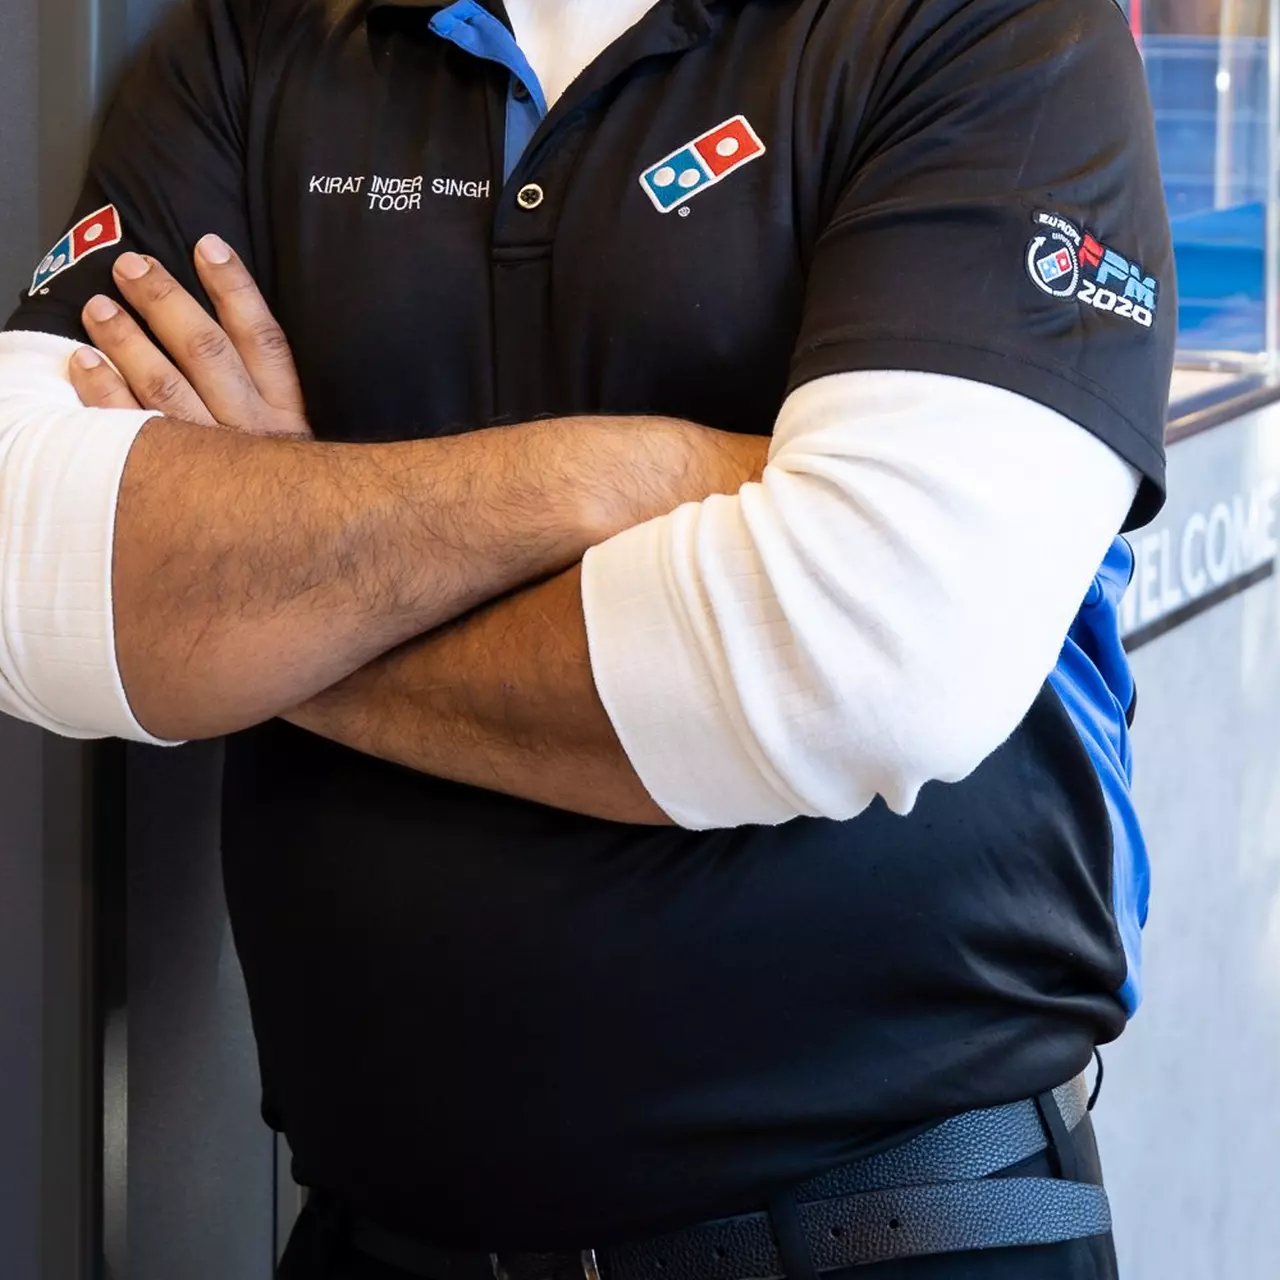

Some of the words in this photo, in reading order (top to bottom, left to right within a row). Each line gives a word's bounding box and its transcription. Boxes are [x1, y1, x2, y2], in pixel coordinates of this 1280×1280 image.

[308, 175, 365, 195] KIRAT
[370, 174, 423, 194] INDER
[431, 178, 490, 198] SINGH
[367, 192, 421, 211] TOOR
[1076, 278, 1154, 328] 2020
